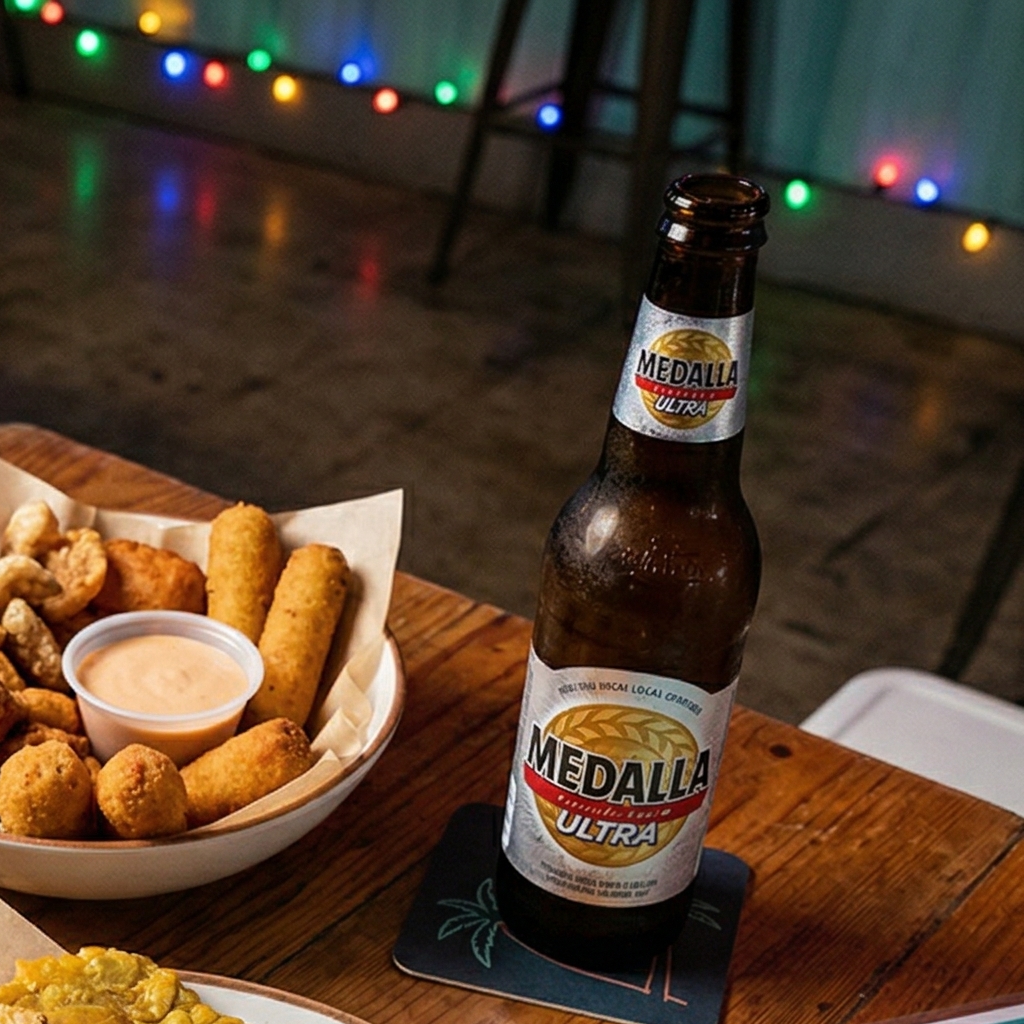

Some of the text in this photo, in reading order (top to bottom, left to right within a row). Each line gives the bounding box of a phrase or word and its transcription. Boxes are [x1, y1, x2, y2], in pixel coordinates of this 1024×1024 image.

[636, 348, 739, 390] MEDALLA
[654, 395, 708, 418] ULTRA
[527, 723, 711, 805] MEDALLA
[555, 808, 658, 846] ULTRA
